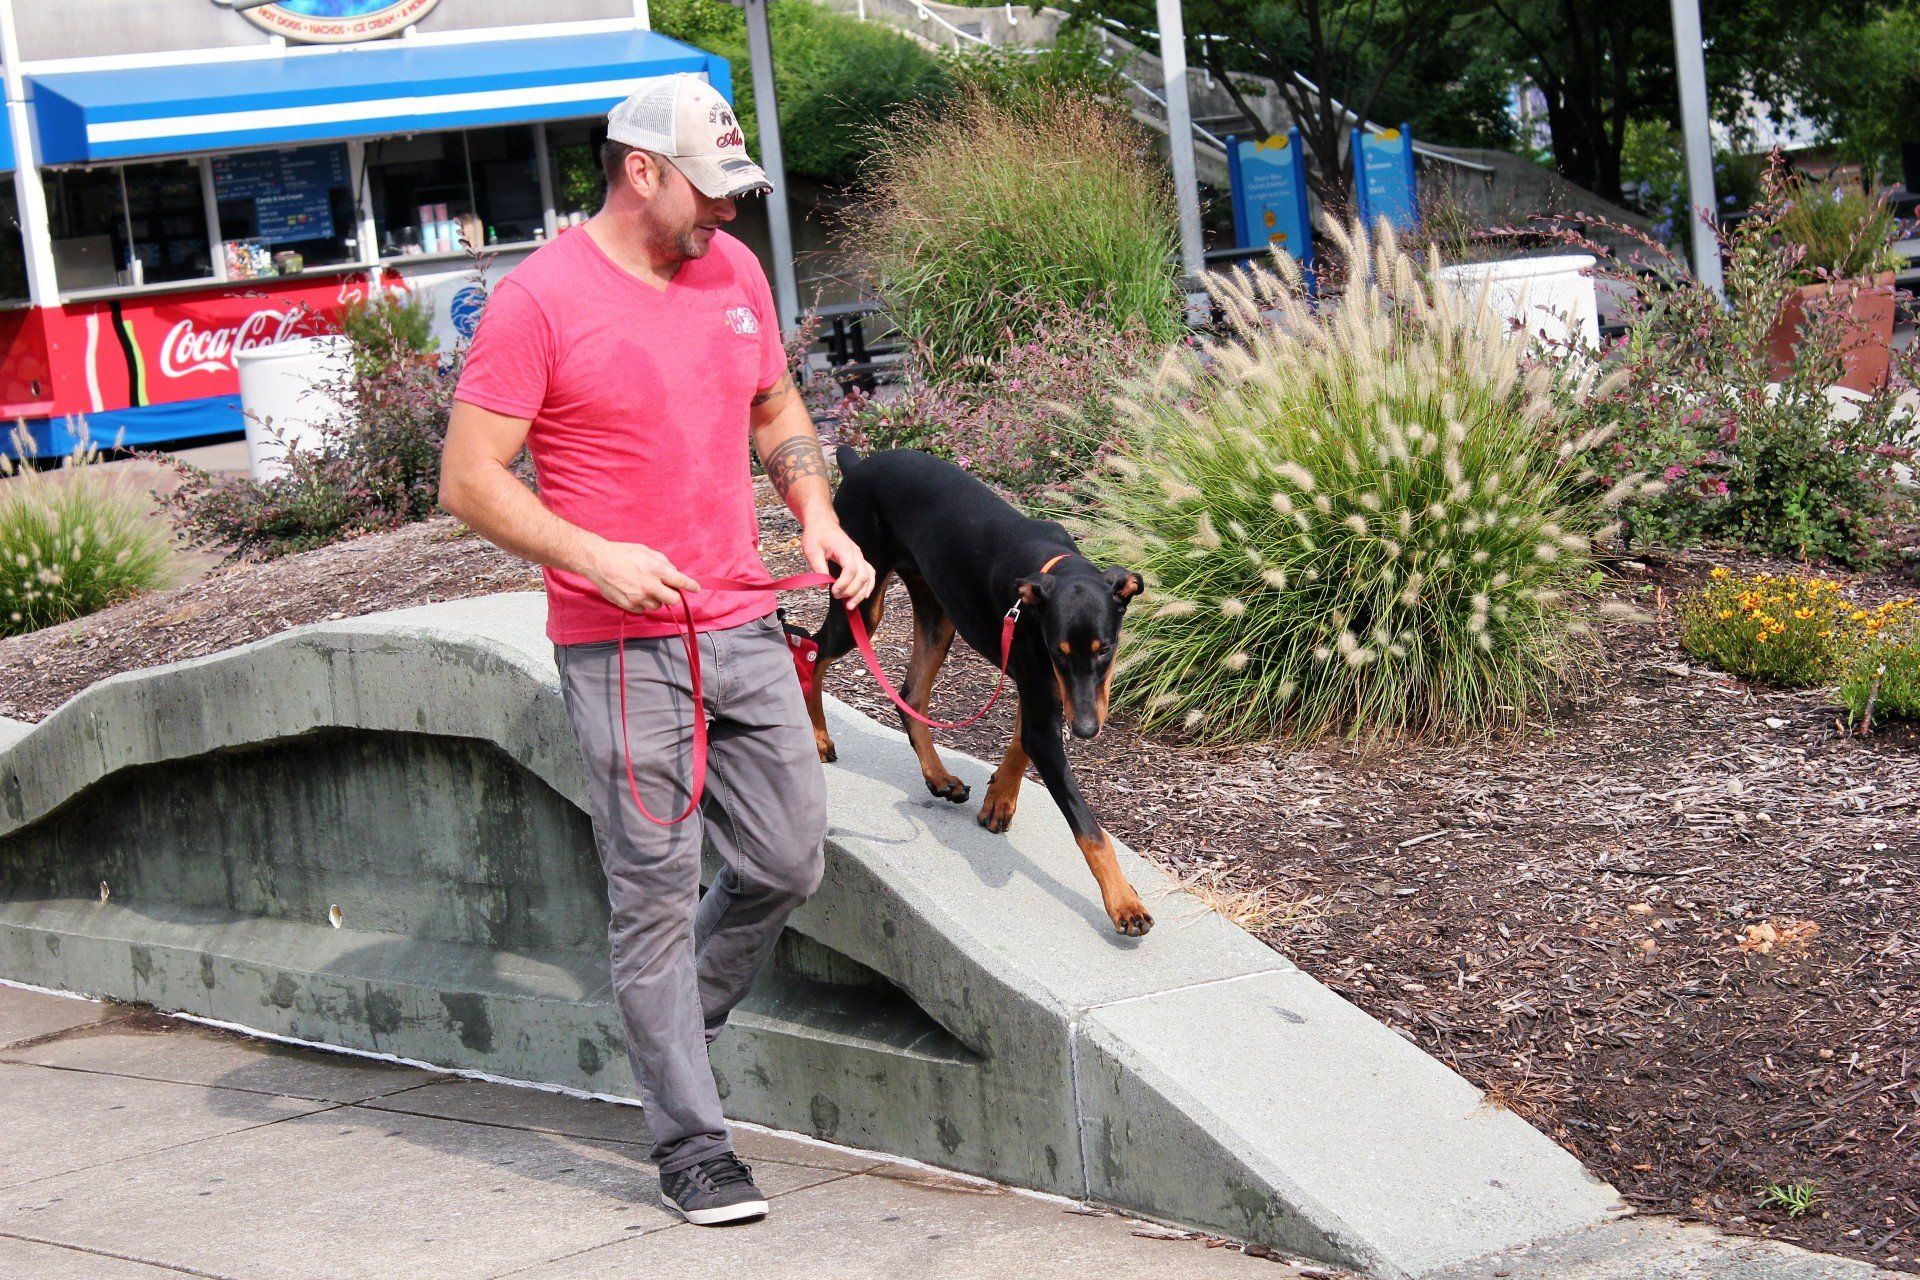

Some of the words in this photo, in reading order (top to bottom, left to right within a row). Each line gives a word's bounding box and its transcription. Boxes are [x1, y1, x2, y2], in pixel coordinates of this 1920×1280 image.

[258, 7, 276, 21] HOT
[277, 16, 302, 31] DOGS
[310, 24, 345, 35] NACHOS
[353, 22, 367, 33] ICE
[368, 14, 395, 30] CREAM
